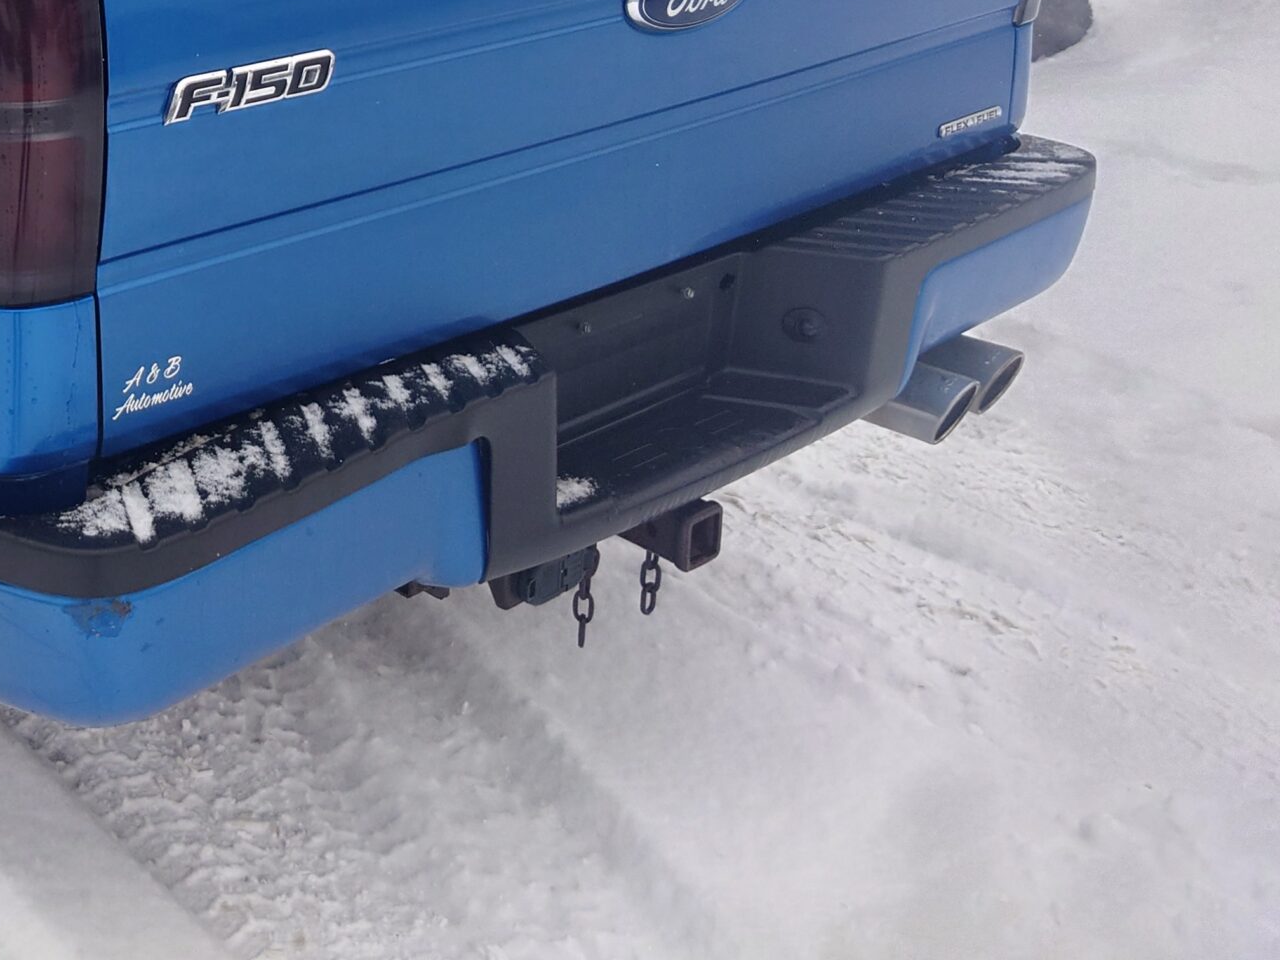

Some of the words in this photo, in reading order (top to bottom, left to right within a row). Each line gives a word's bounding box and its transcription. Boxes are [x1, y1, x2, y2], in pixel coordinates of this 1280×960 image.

[164, 49, 335, 126] F-150
[945, 120, 969, 135] FLEX
[122, 366, 145, 393] A
[146, 362, 161, 384] &
[163, 355, 182, 379] B
[112, 380, 193, 421] Automotive
